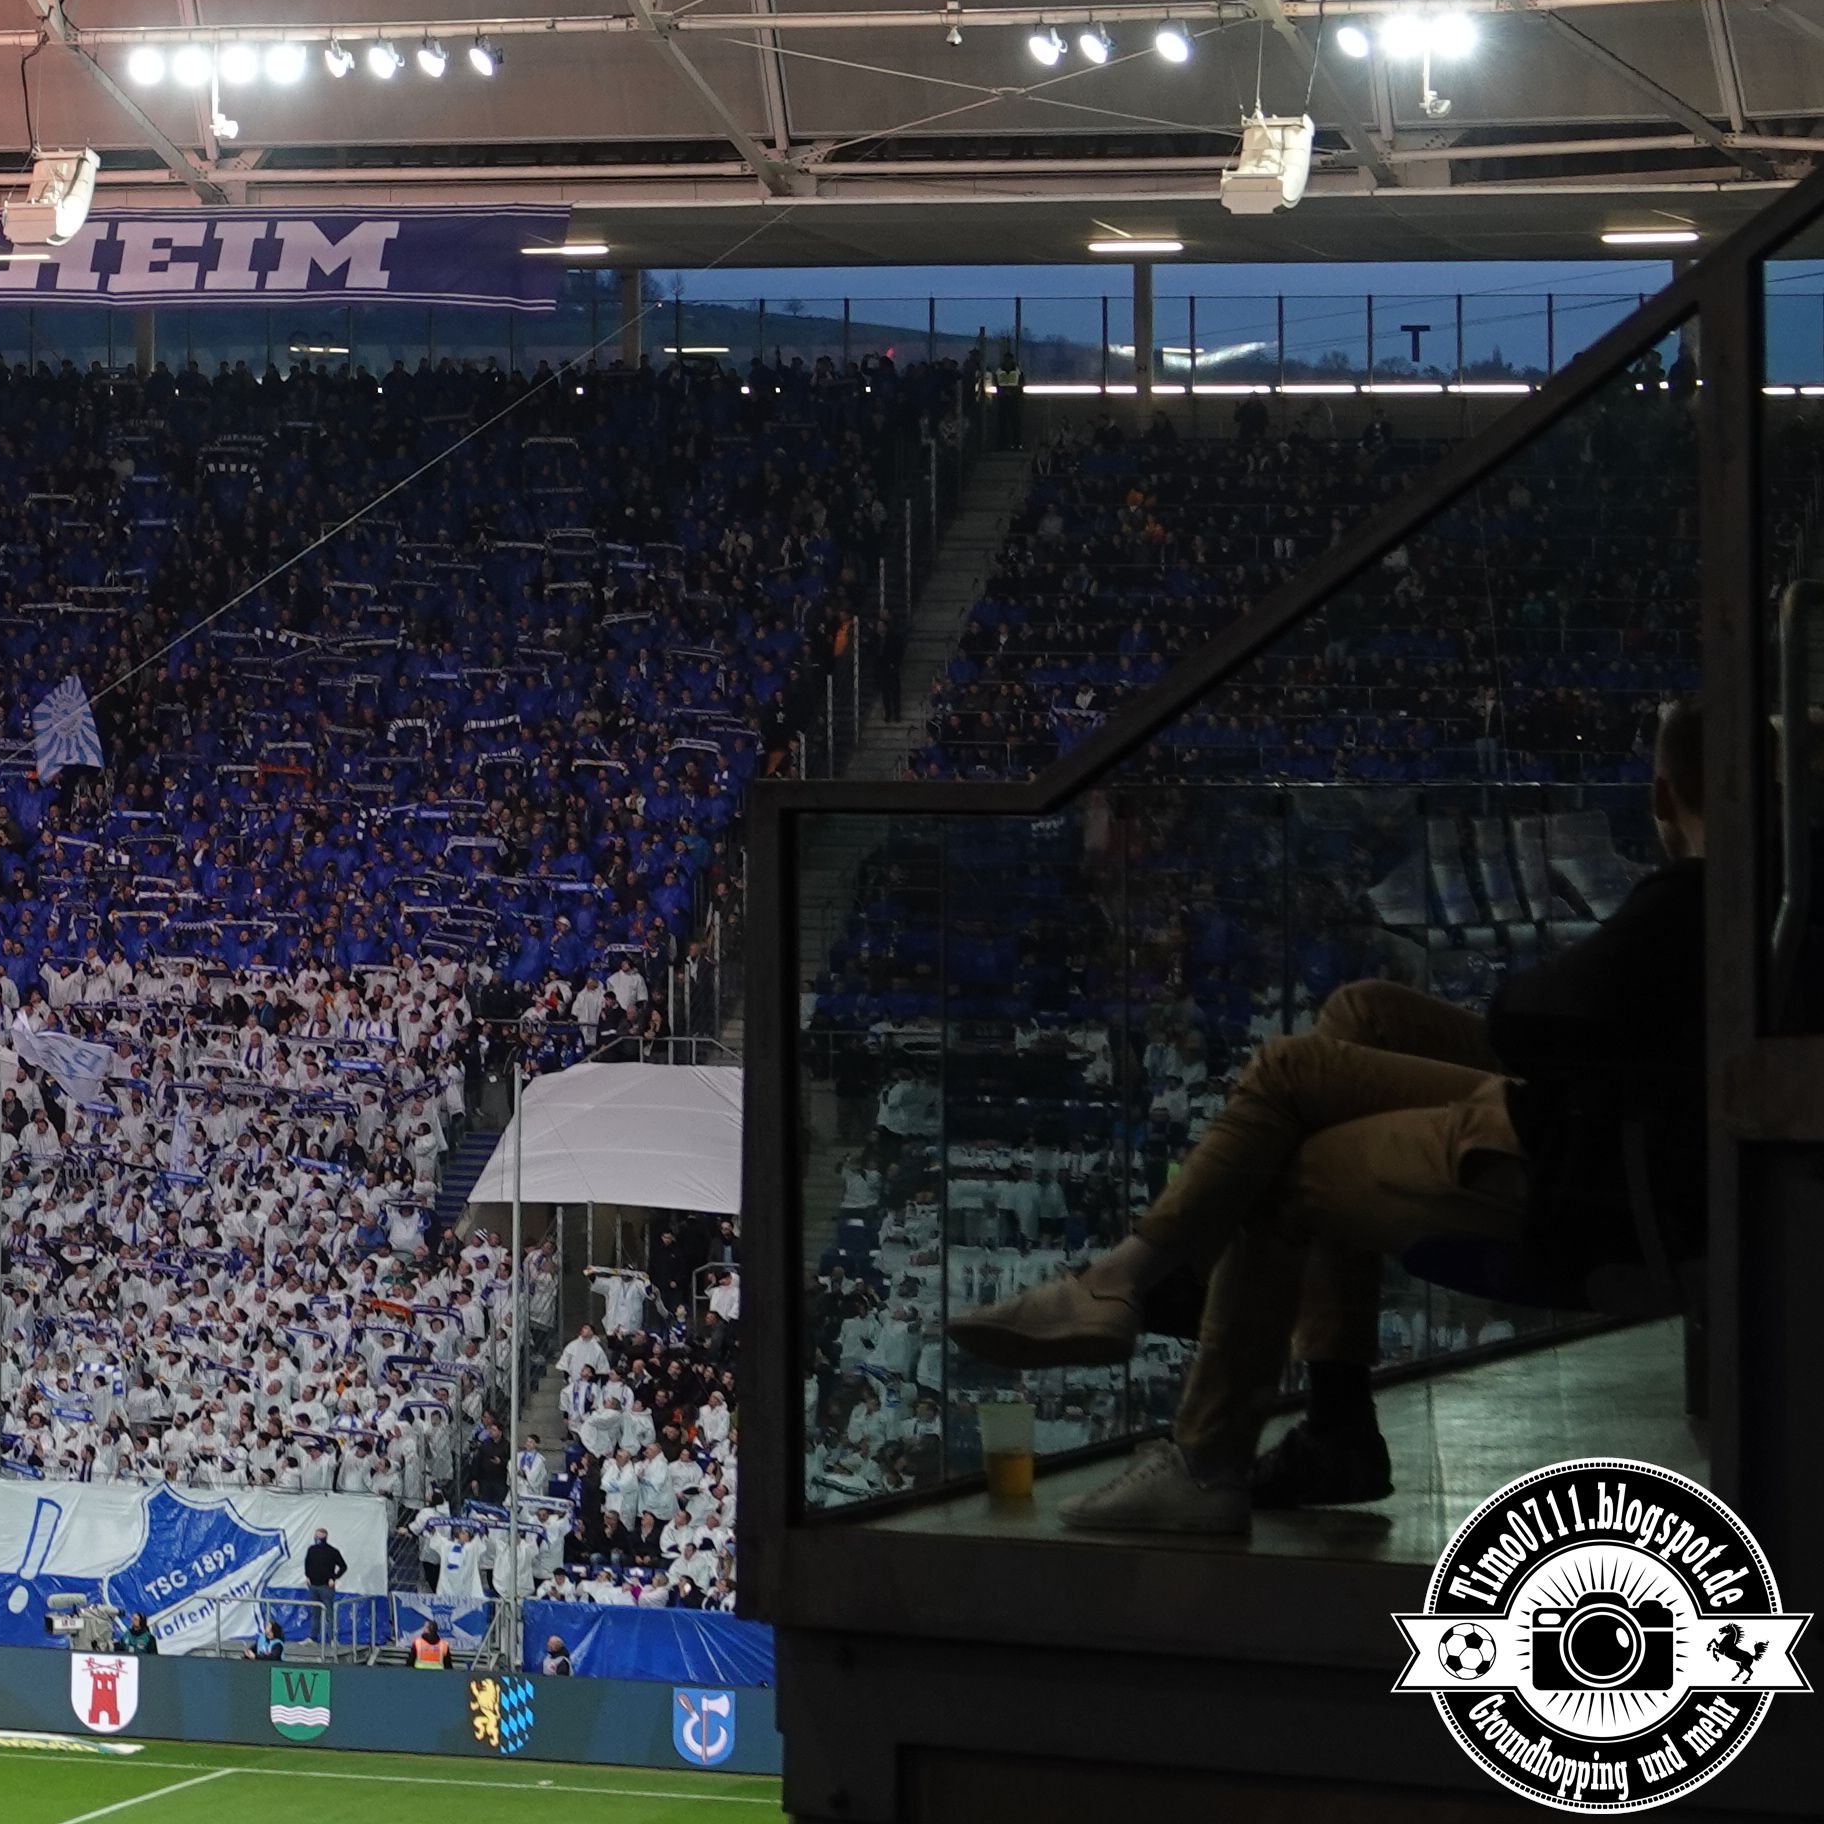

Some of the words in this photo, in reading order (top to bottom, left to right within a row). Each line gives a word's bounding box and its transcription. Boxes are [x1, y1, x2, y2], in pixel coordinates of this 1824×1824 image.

[1399, 324, 1432, 364] T
[145, 1567, 188, 1601] TSG
[191, 1542, 236, 1578] 1899
[281, 1670, 319, 1703] W
